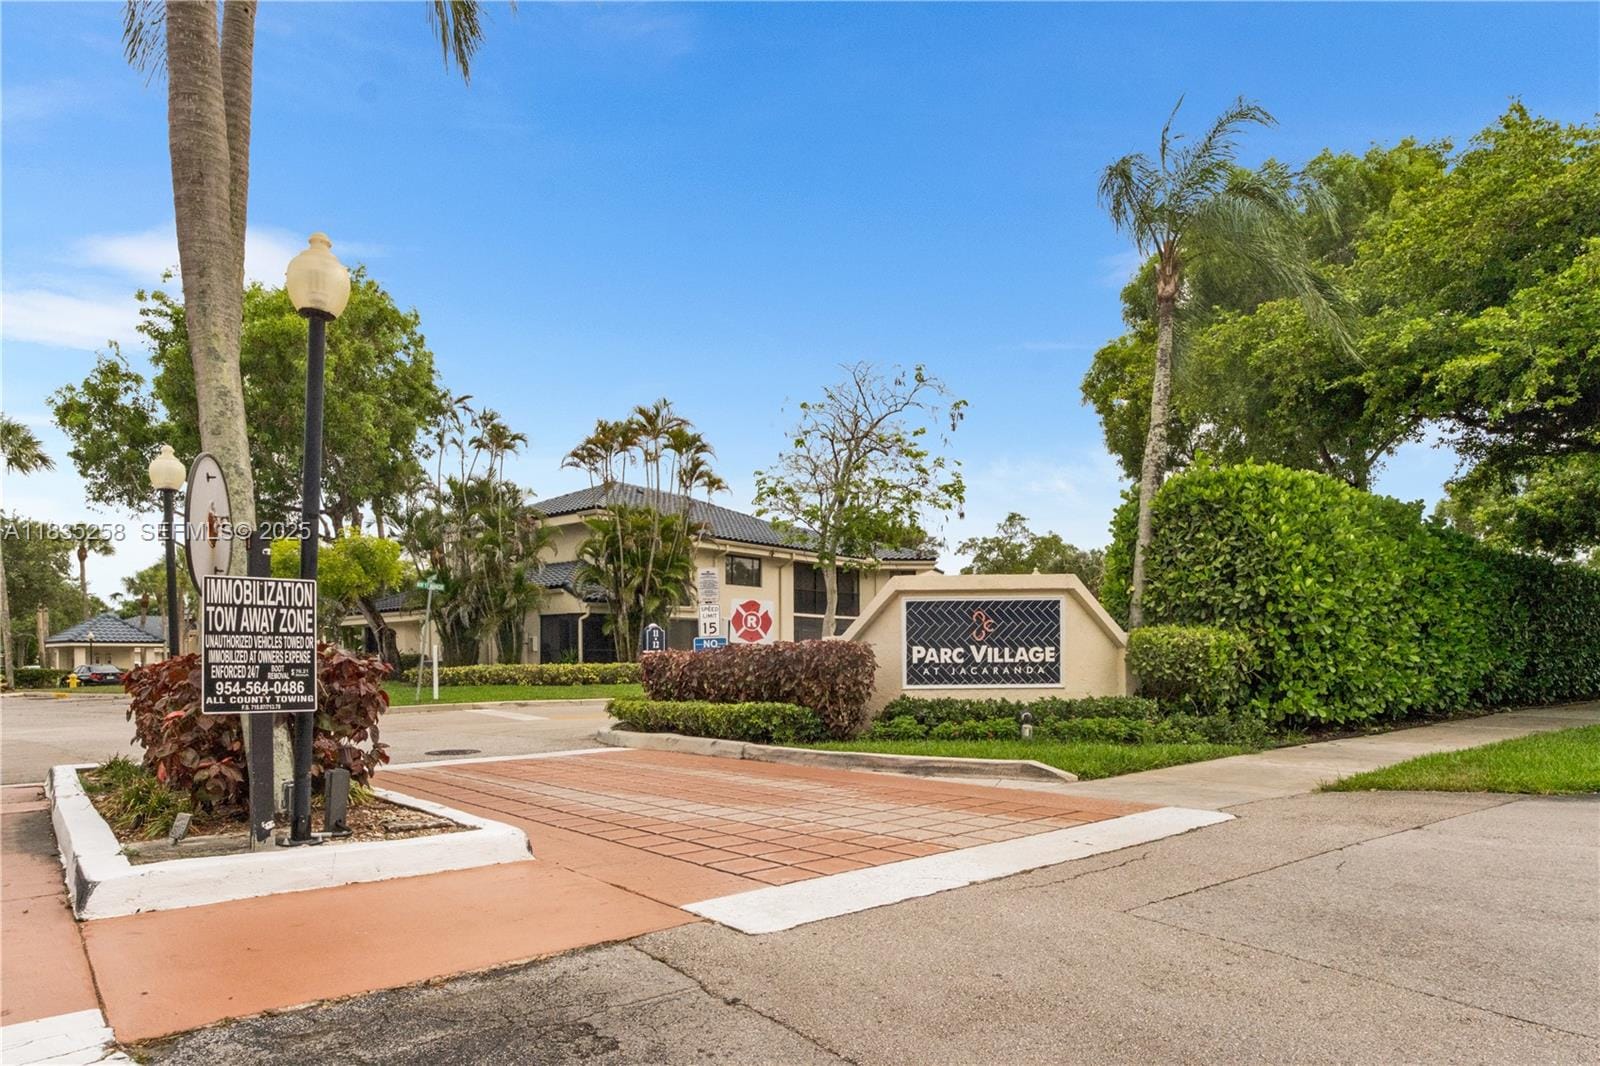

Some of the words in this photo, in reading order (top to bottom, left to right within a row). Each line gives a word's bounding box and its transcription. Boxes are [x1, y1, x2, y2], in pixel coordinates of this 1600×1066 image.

[206, 579, 313, 607] IMMOBILIZATION
[206, 606, 238, 632] TOW
[240, 607, 277, 633] AWAY
[279, 608, 313, 633] ZONE
[746, 615, 757, 628] R
[703, 622, 717, 634] 15
[205, 635, 253, 648] UNAUTHORIZED
[254, 635, 283, 648] VEHICLES
[283, 635, 304, 648] TOWED
[304, 636, 314, 648] OR
[703, 639, 718, 648] NO
[208, 650, 248, 663] IMMOBILIZED
[249, 650, 257, 663] AT
[257, 650, 284, 663] OWNERS
[284, 651, 311, 664] EXPENSE
[912, 646, 965, 664] PARC
[970, 645, 1056, 663] VILLAGE
[211, 665, 247, 679] ENFORCED
[247, 665, 260, 679] 24/7
[922, 667, 940, 675] AT
[951, 666, 1045, 675] JACARANDA
[215, 681, 305, 695] 954-564-0486
[205, 696, 226, 705] ALL
[229, 696, 272, 704] COUNTY
[276, 695, 314, 703] TOWING
